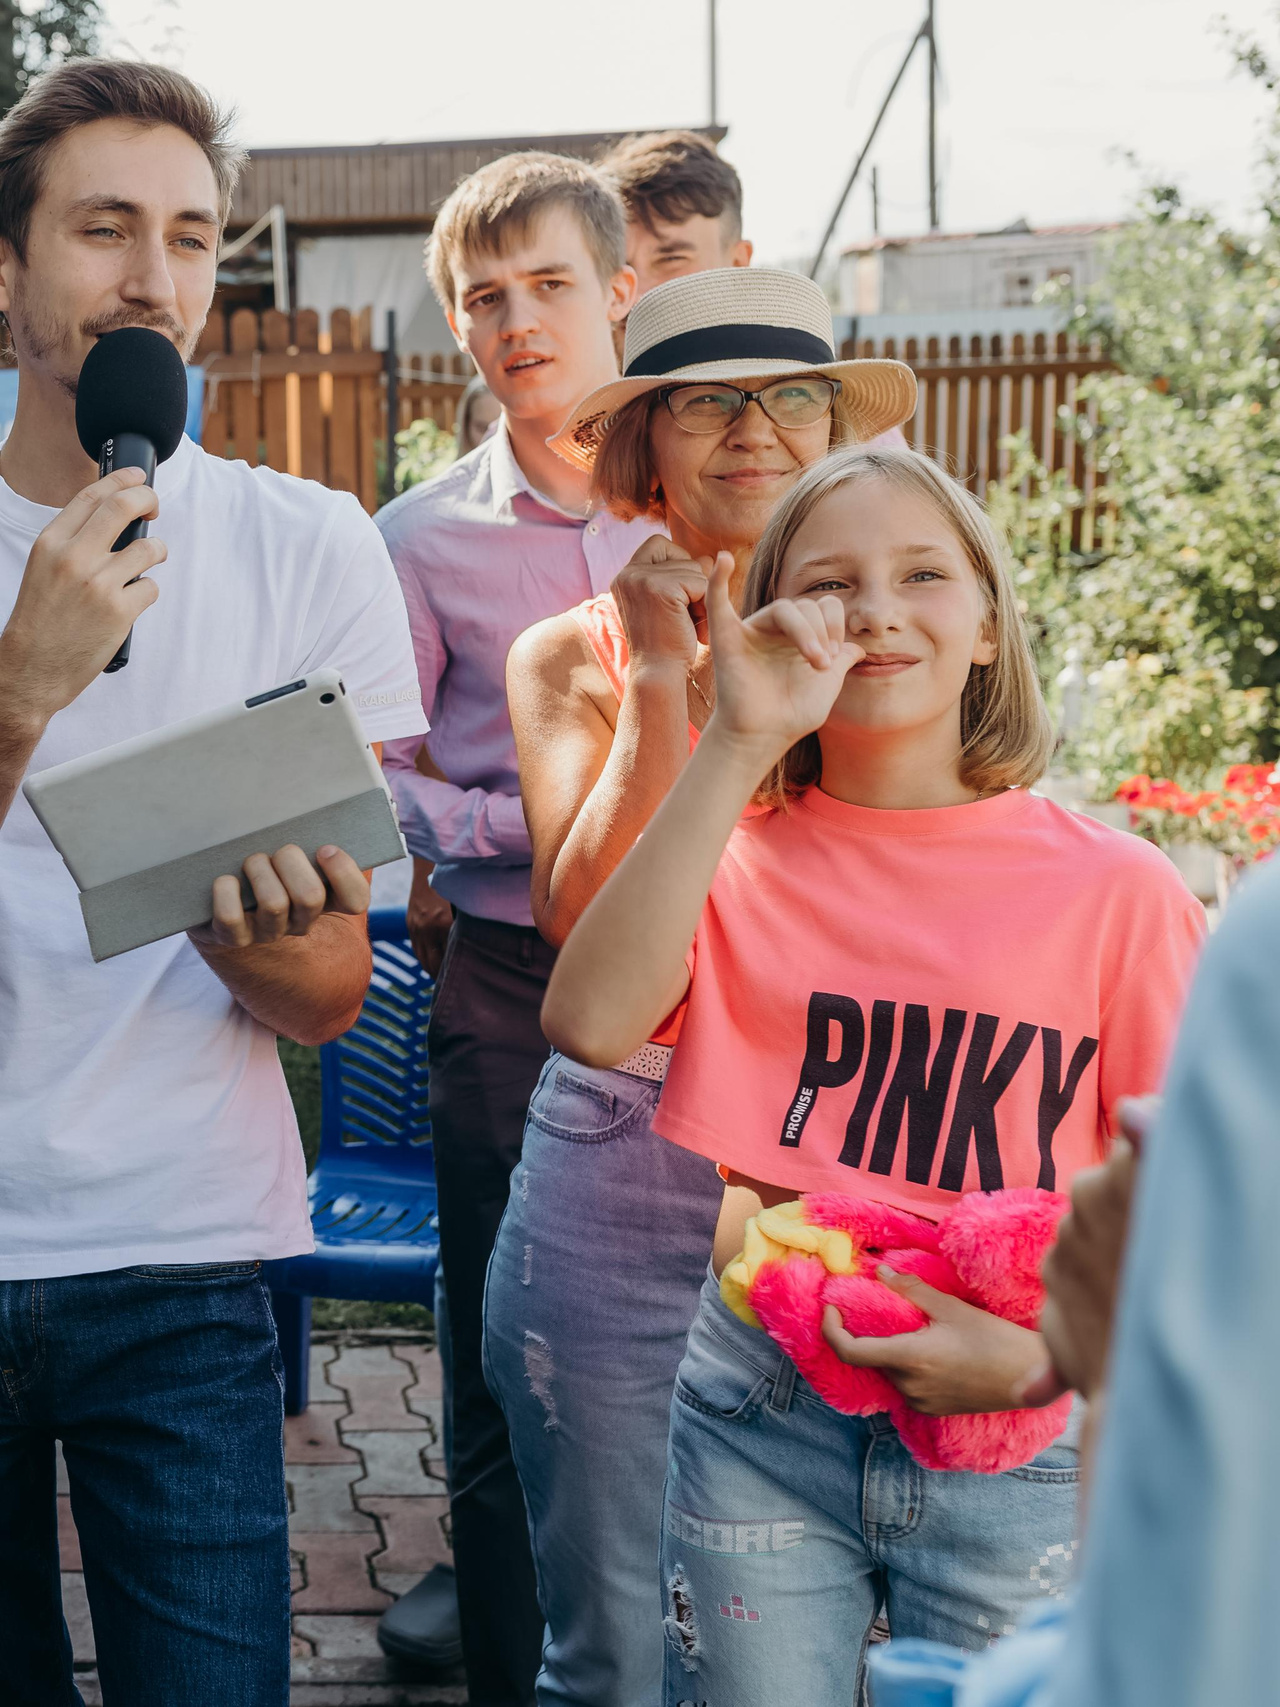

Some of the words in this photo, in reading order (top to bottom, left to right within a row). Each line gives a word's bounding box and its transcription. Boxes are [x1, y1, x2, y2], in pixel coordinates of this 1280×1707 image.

[358, 692, 394, 707] KARL
[779, 991, 1099, 1195] PINKY
[785, 1087, 813, 1139] PROMISE
